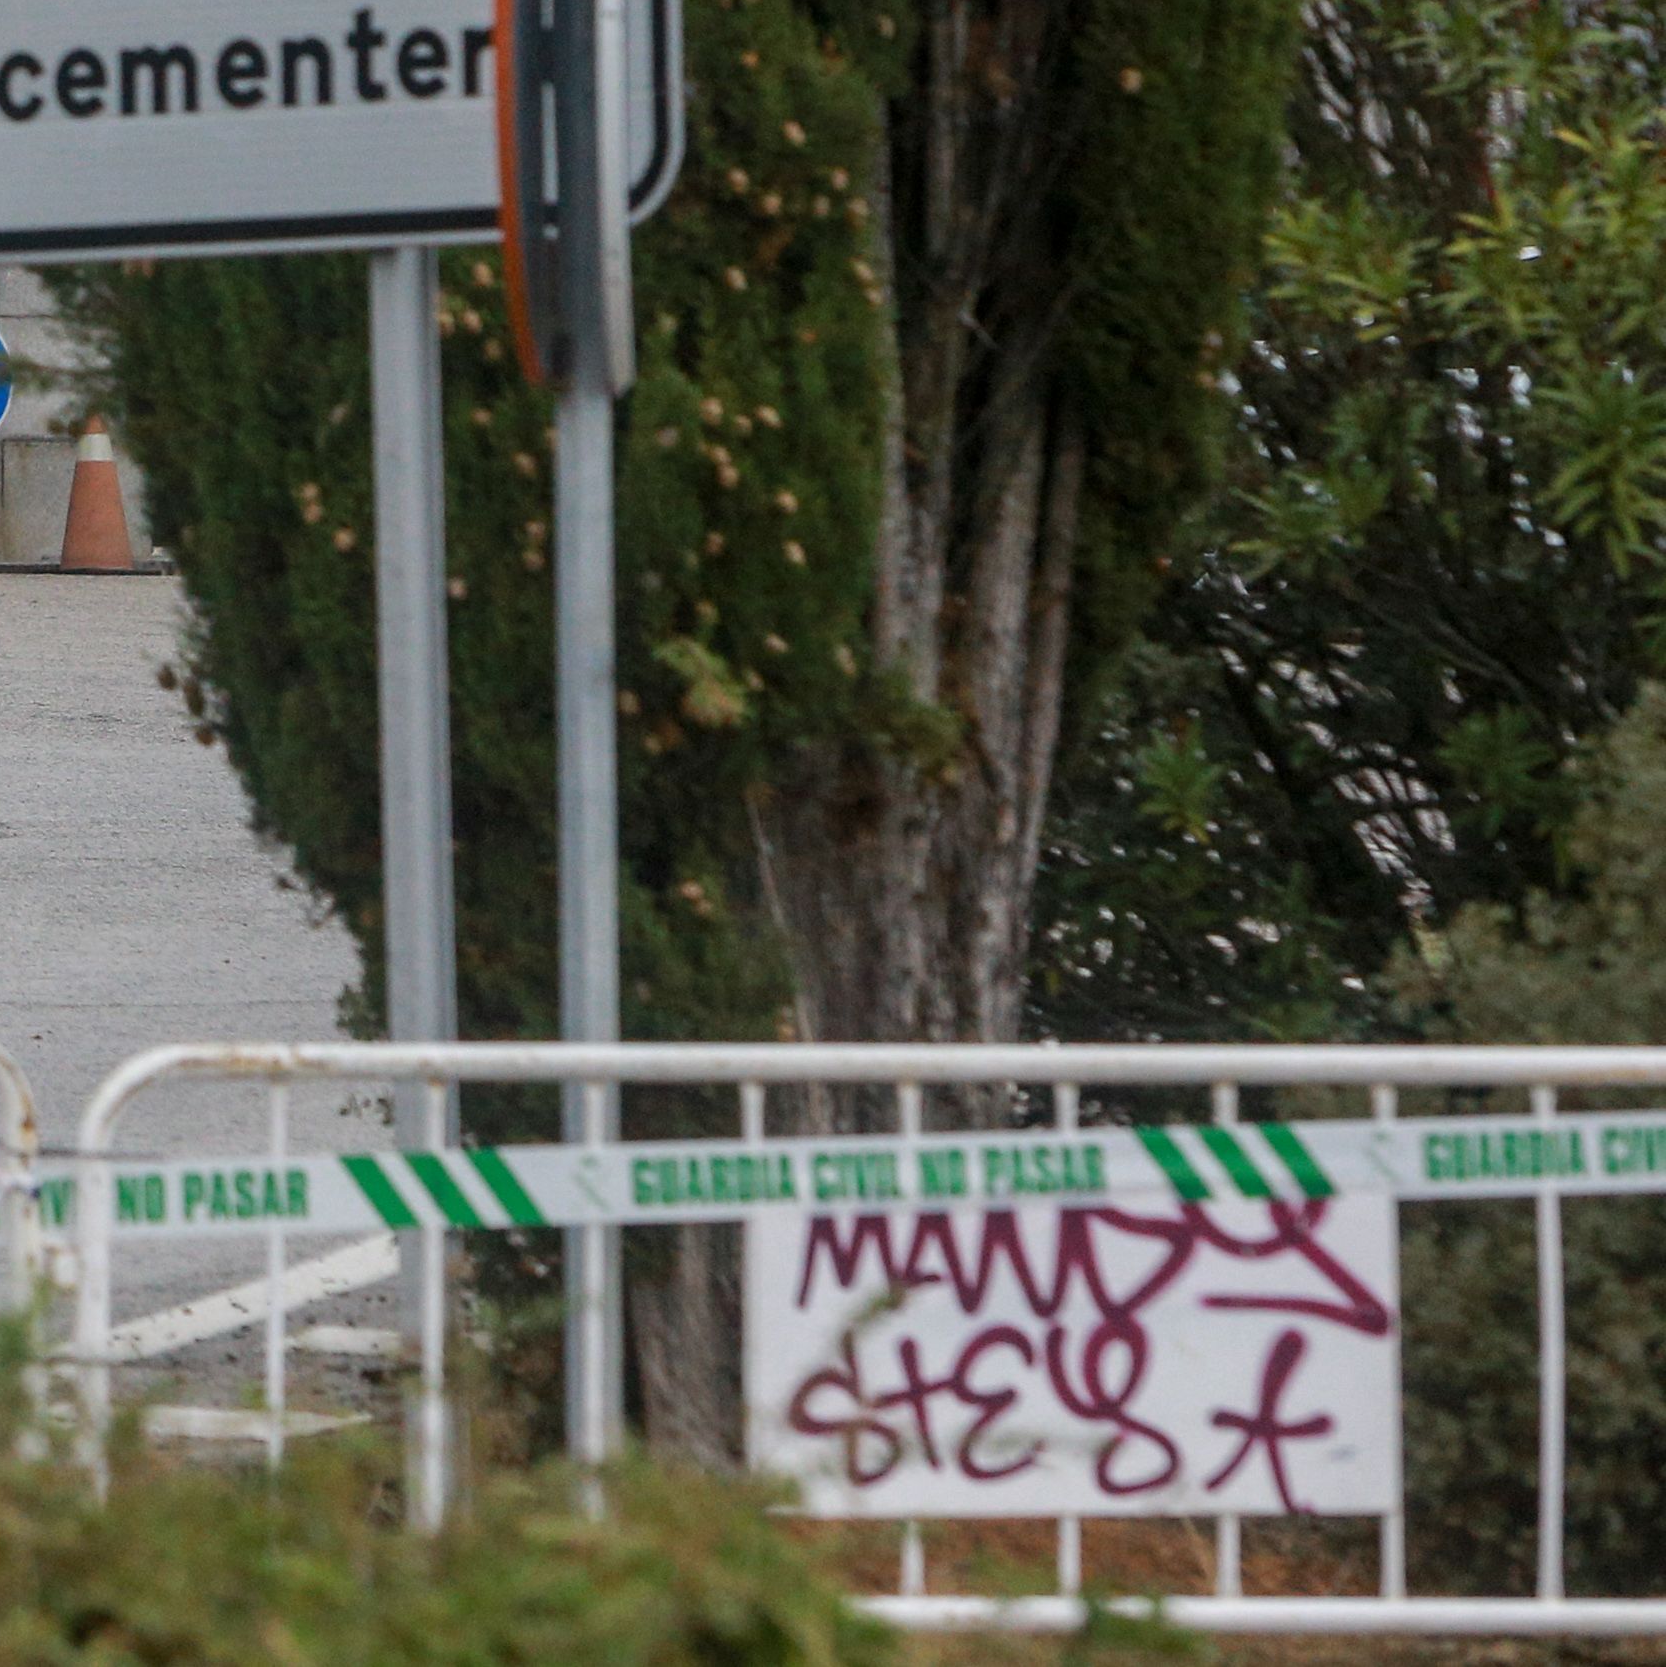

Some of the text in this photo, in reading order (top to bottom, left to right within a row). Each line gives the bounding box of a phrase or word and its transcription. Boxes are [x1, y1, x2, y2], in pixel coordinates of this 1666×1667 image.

[116, 1172, 166, 1224] NO
[183, 1168, 308, 1222] PASAR
[632, 1143, 1107, 1205] GUARDIA CIVIL NO PASAR
